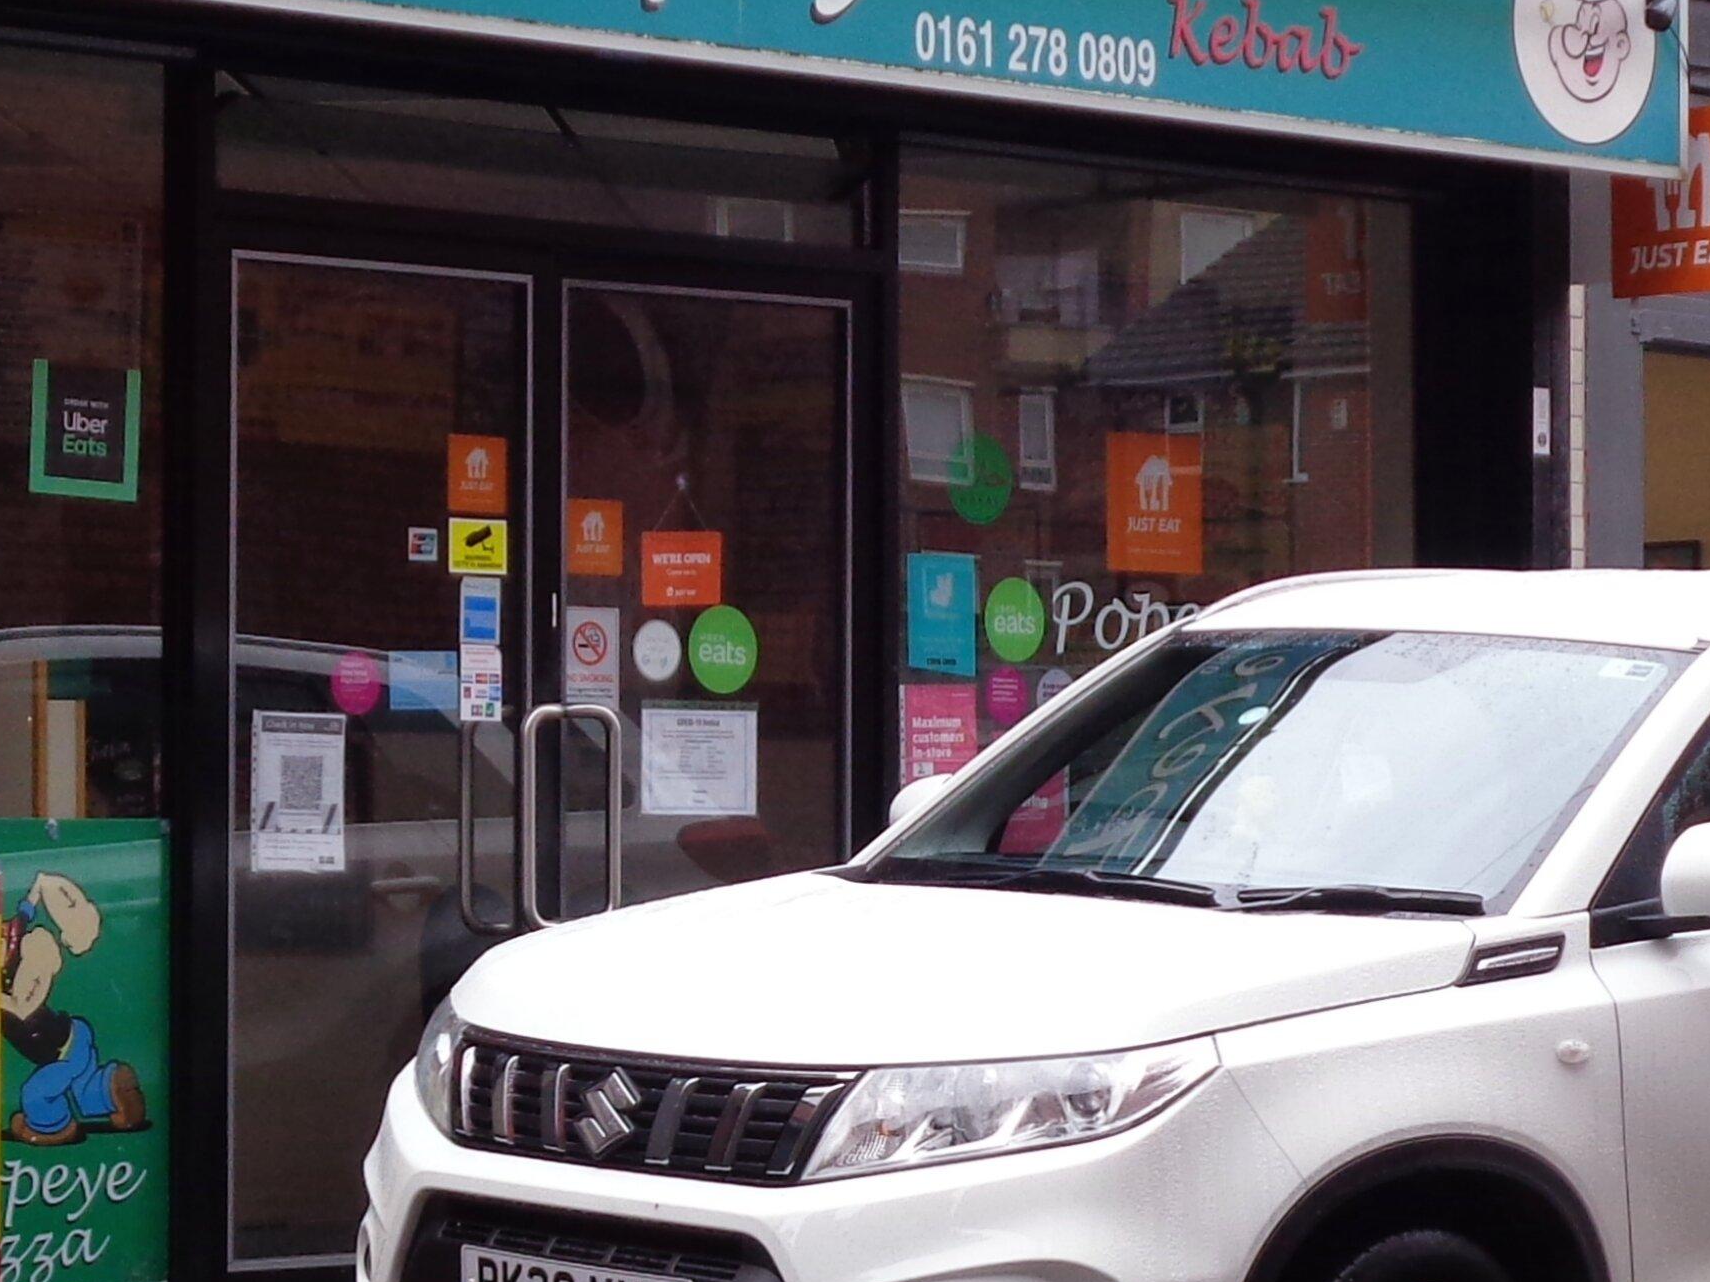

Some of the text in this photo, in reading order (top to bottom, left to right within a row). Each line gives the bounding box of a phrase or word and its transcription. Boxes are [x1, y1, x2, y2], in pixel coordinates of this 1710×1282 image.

[916, 11, 1156, 88] 0161 278 0809
[1629, 241, 1685, 274] JUST
[63, 410, 109, 434] Uber
[62, 433, 107, 456] Eats
[1127, 517, 1182, 533] JUST EAT
[683, 553, 711, 565] OPEN
[994, 612, 1036, 634] eats
[1052, 581, 1202, 654] Pop
[699, 640, 747, 665] eats
[912, 715, 961, 728] Maximum
[912, 731, 964, 744] customers
[0, 1159, 147, 1228] peye
